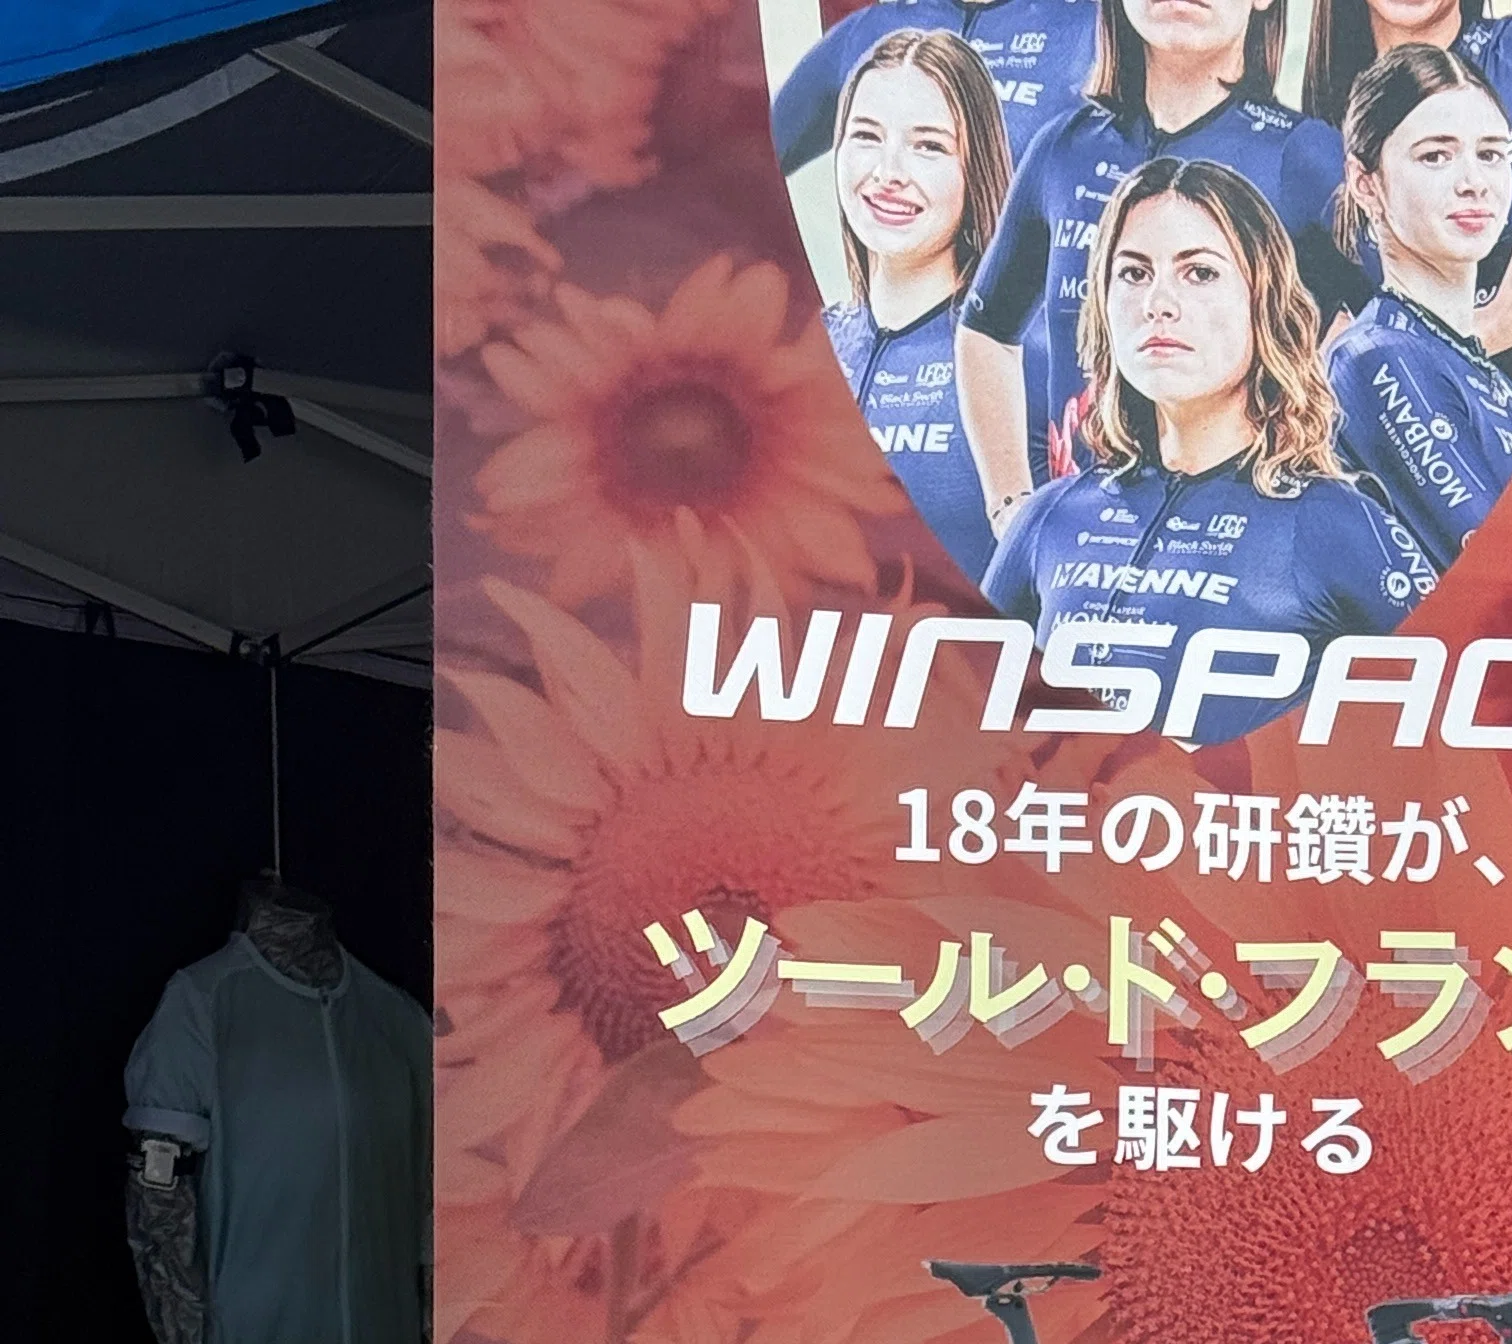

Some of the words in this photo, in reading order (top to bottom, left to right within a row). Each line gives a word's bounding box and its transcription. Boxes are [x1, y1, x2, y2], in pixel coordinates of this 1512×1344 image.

[1372, 362, 1473, 508] MONBANA
[1050, 562, 1239, 605] MAYENNE
[895, 781, 1508, 887] 18年の研鑽が、
[1027, 1083, 1374, 1178] を駆ける
